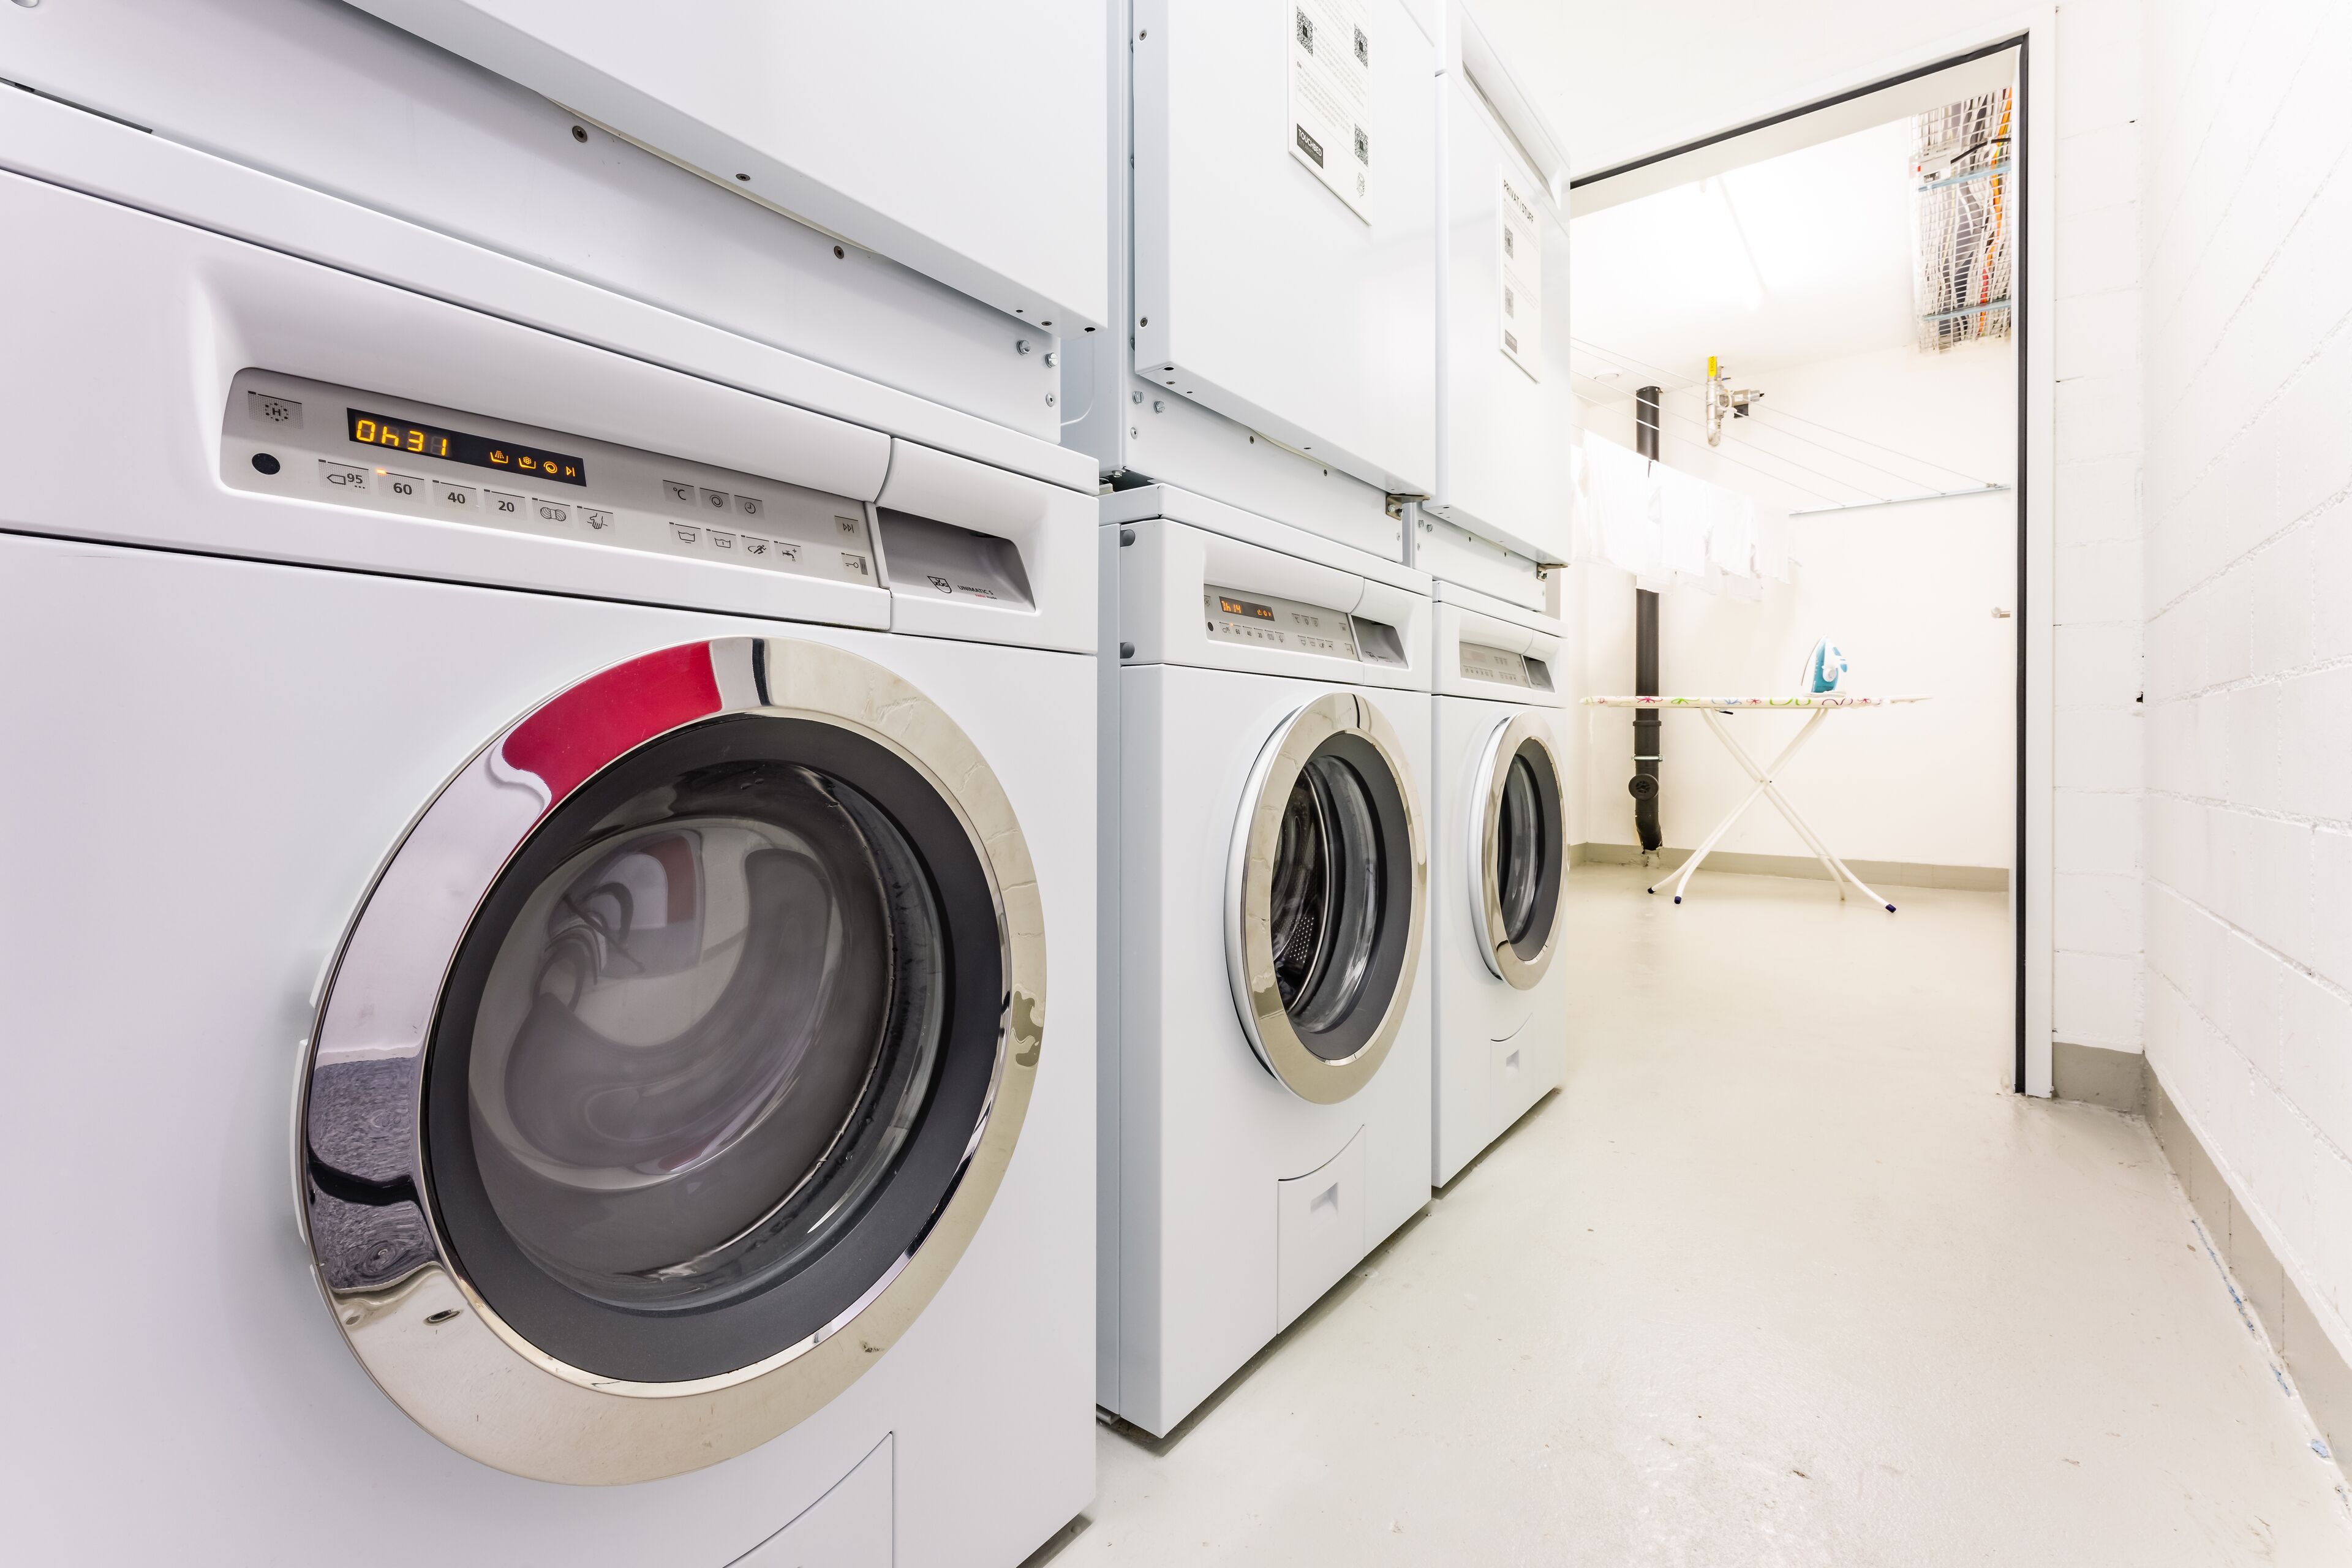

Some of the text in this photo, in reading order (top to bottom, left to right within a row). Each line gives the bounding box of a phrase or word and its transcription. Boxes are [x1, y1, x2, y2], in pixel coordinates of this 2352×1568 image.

[1298, 129, 1322, 156] TOUCHBED
[1504, 179, 1519, 206] PRIVAT
[1522, 203, 1533, 224] STUFF
[356, 420, 447, 456] 0h31
[347, 473, 515, 513] 95 60 40 20
[957, 585, 989, 594] UNIMATIC
